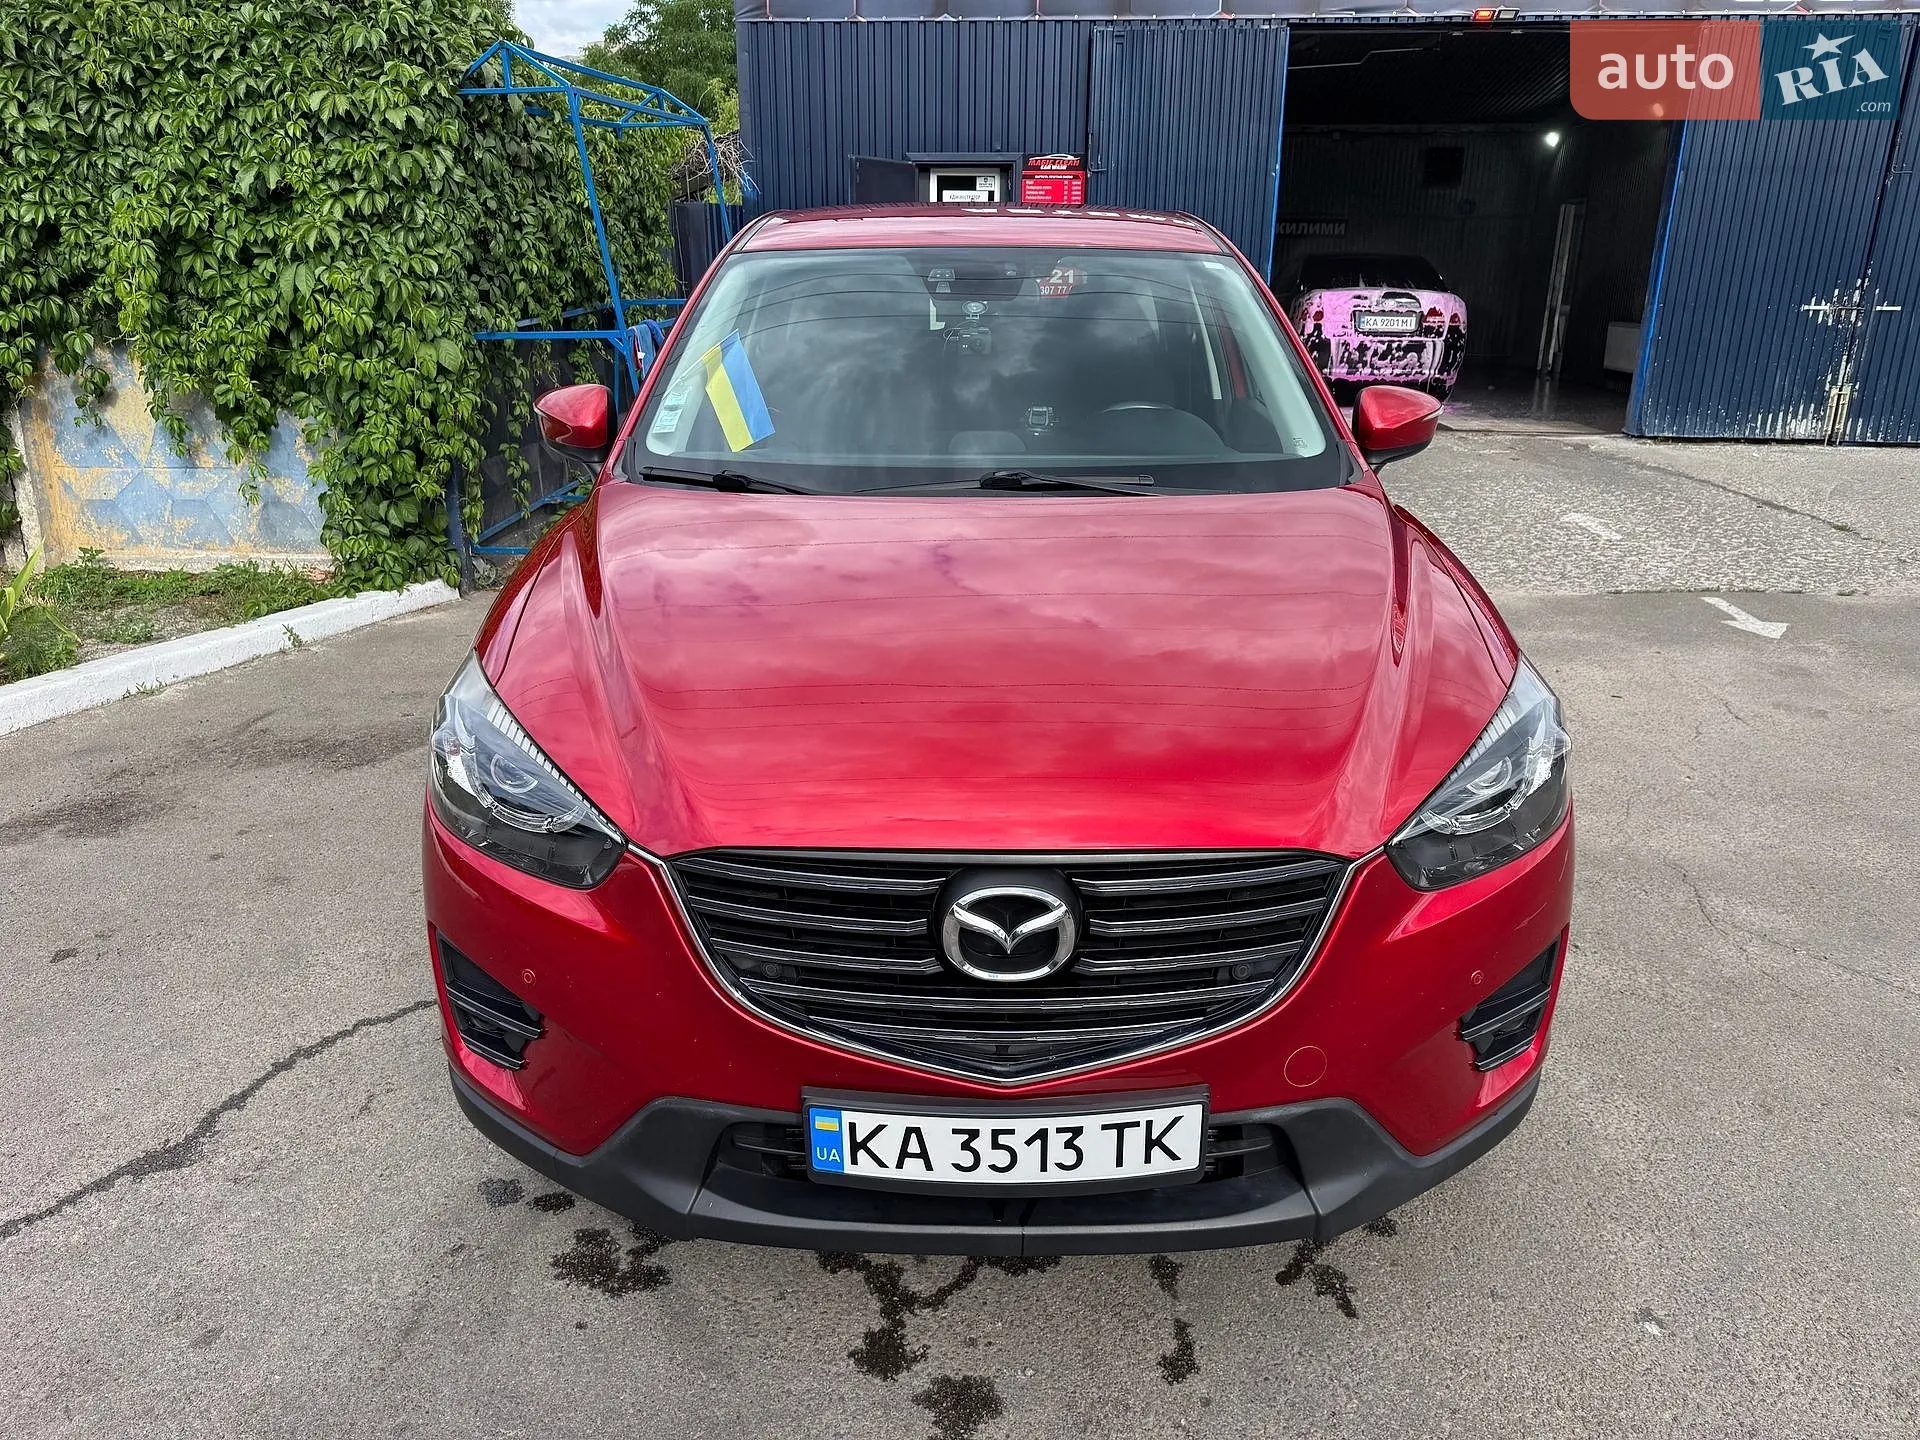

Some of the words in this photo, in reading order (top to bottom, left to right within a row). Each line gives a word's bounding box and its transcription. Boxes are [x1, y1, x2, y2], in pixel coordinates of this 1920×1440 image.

[1049, 269, 1074, 284] 21
[1040, 286, 1055, 295] 307
[1366, 318, 1378, 327] KA
[1380, 318, 1400, 327] 9201
[848, 1121, 934, 1172] KA
[950, 1125, 1087, 1173] 3513
[1100, 1114, 1185, 1168] TK
[816, 1147, 841, 1163] UA
